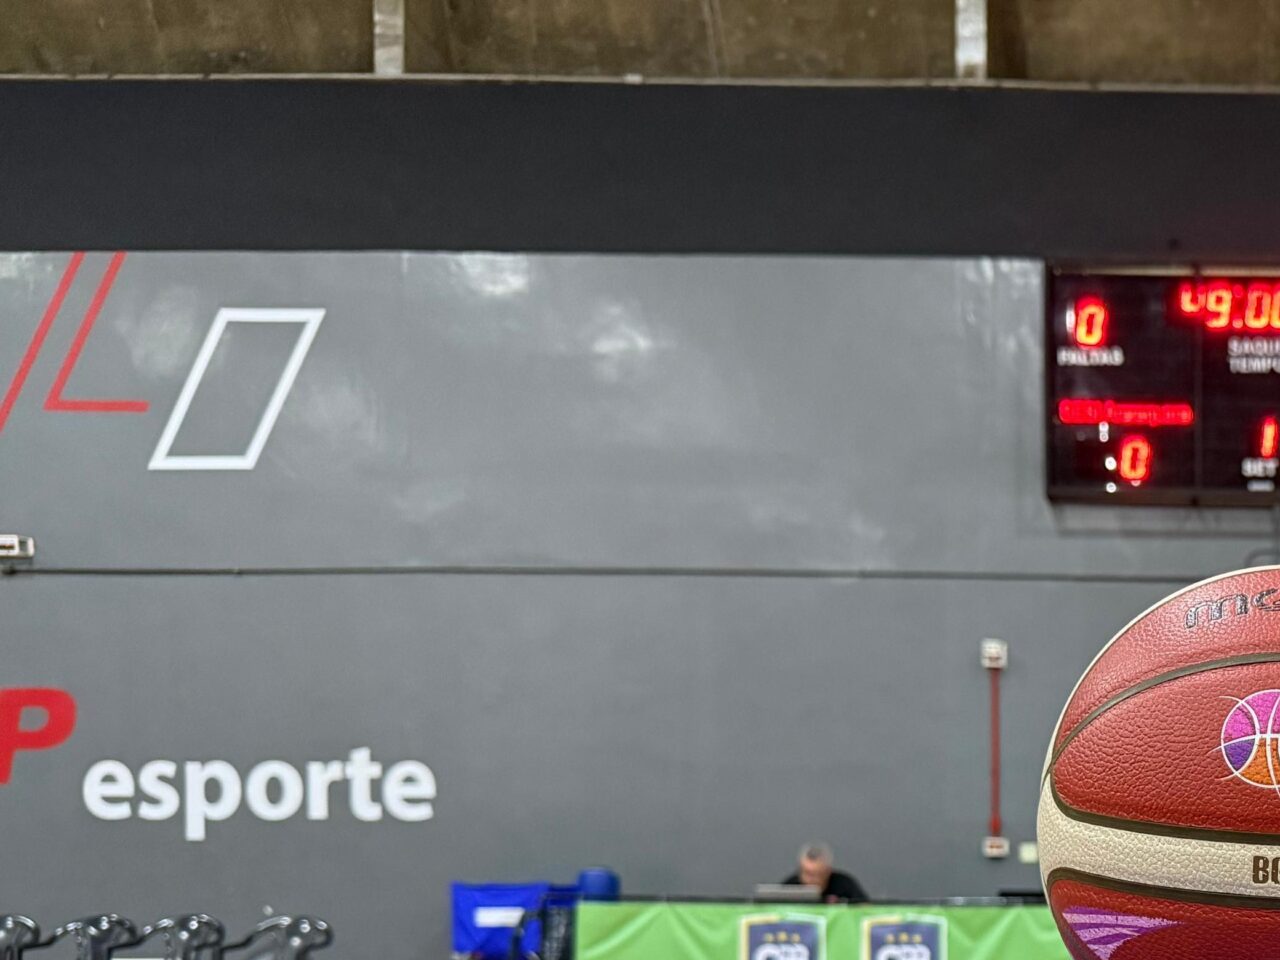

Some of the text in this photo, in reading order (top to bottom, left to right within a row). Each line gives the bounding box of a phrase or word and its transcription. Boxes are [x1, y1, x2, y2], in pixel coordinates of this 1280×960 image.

[1074, 299, 1106, 346] 0
[1119, 436, 1151, 481] 0
[1260, 417, 1278, 458] 1
[82, 746, 438, 842] esporte
